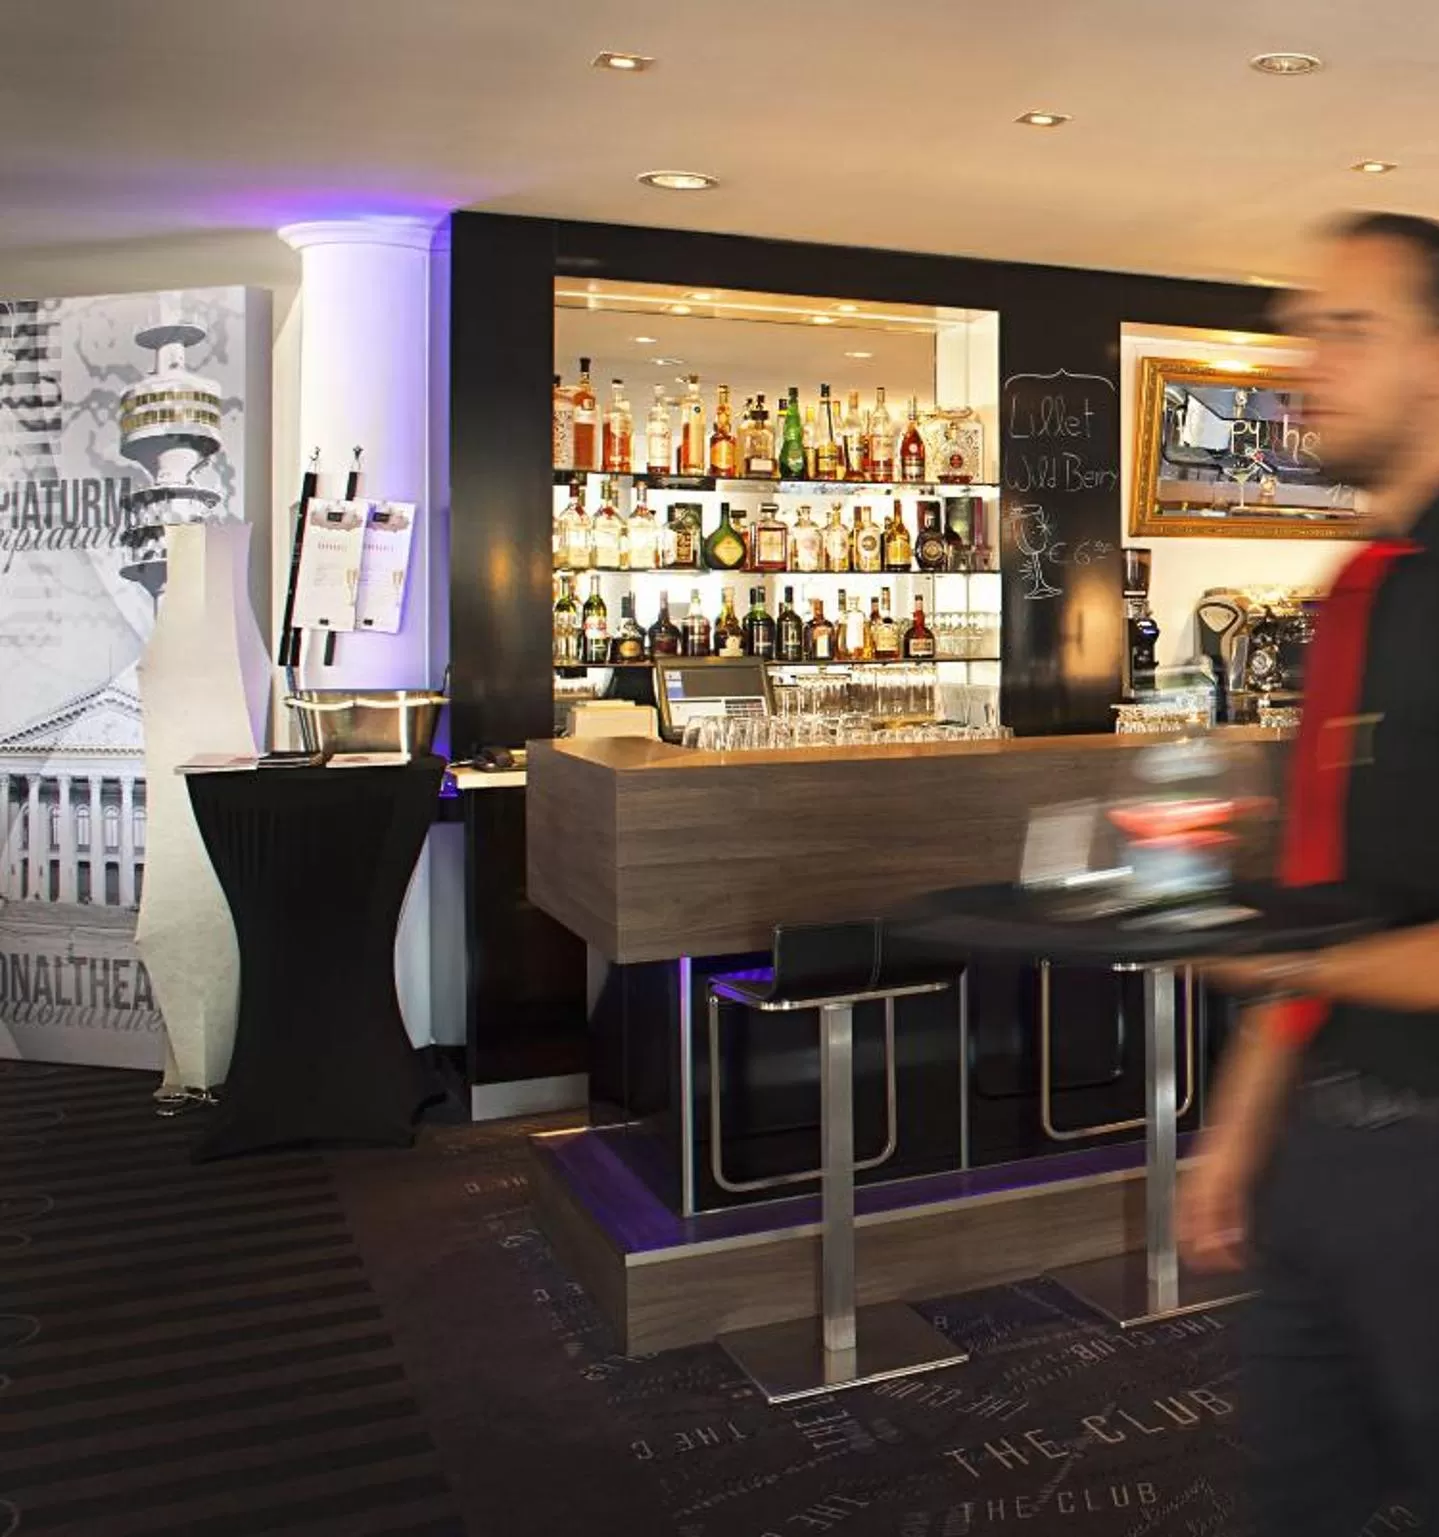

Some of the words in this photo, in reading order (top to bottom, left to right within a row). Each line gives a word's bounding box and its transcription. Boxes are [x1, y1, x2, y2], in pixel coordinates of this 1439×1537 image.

[1010, 395, 1096, 438] Lillet
[1005, 454, 1057, 492] Wild
[944, 1427, 1071, 1480] THE
[1080, 1386, 1235, 1445] CLUB
[958, 1495, 1040, 1525] THE
[1057, 1480, 1159, 1516] CLUB
